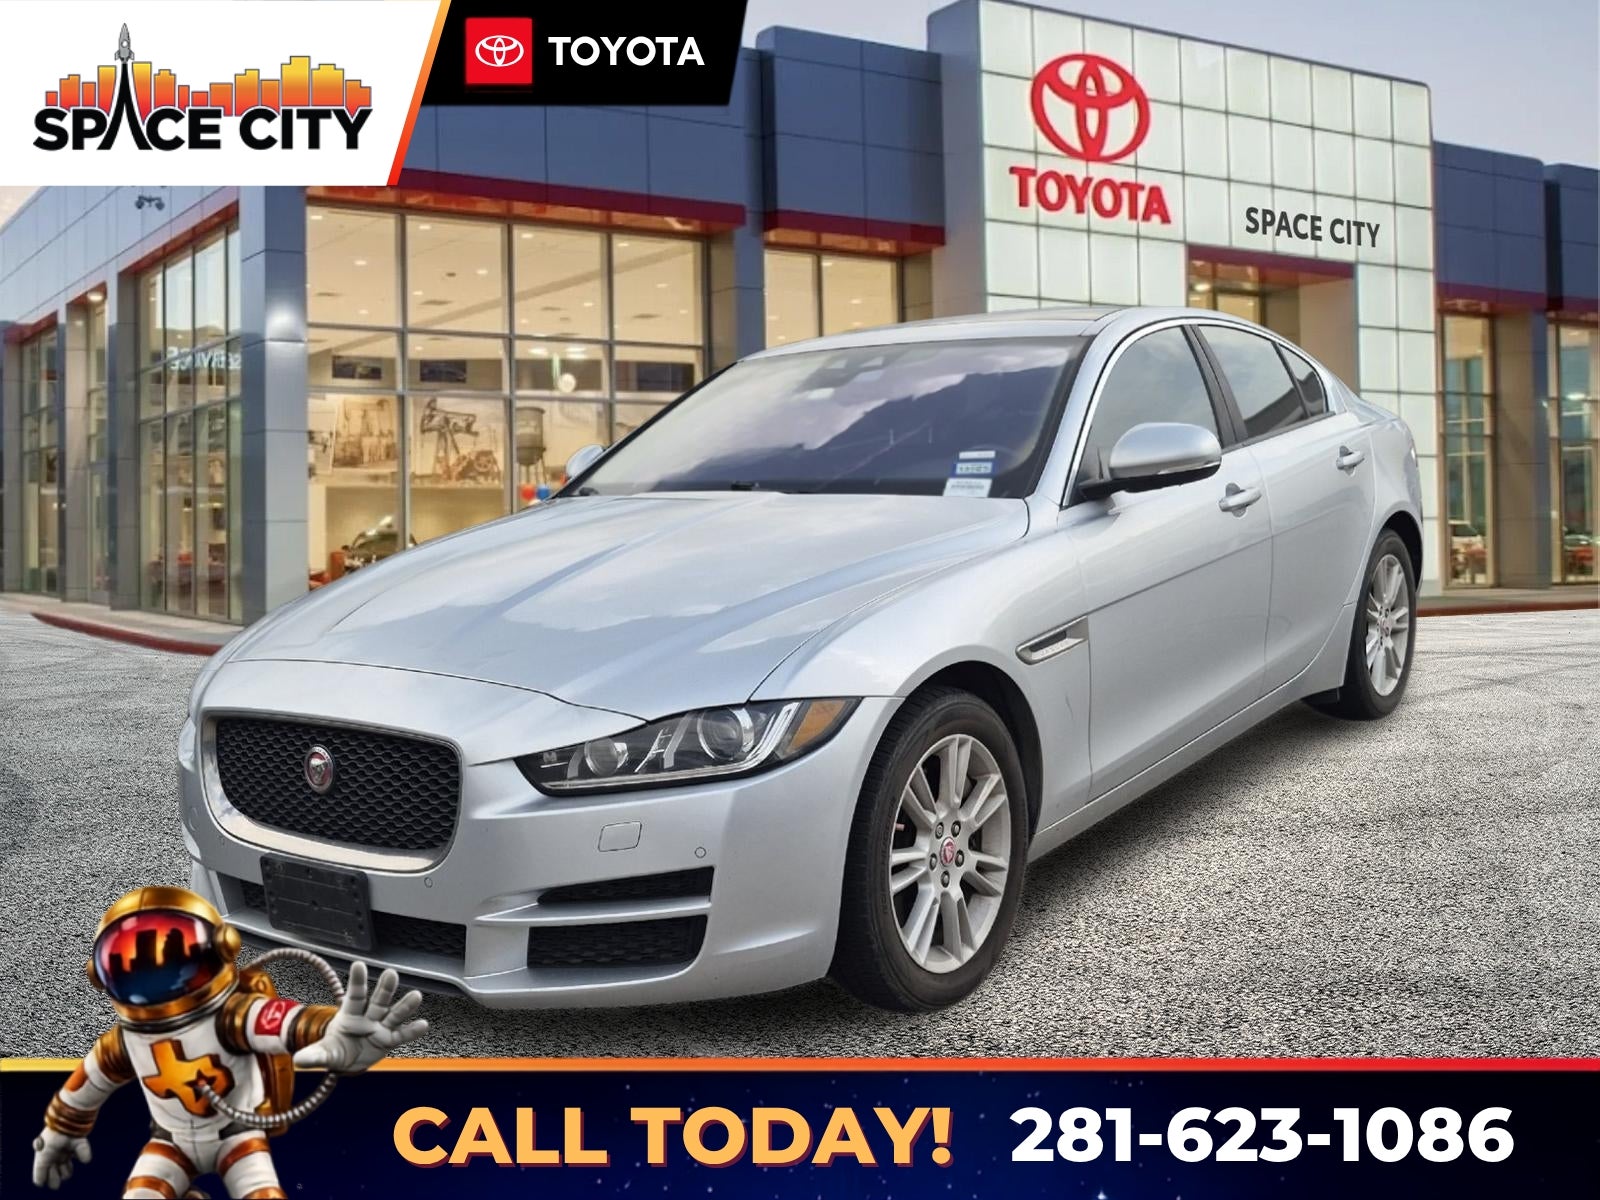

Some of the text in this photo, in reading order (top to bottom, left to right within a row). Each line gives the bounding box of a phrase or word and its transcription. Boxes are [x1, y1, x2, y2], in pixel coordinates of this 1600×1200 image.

[1009, 166, 1171, 225] TOYOTA
[1245, 206, 1381, 248] SPACE CITY
